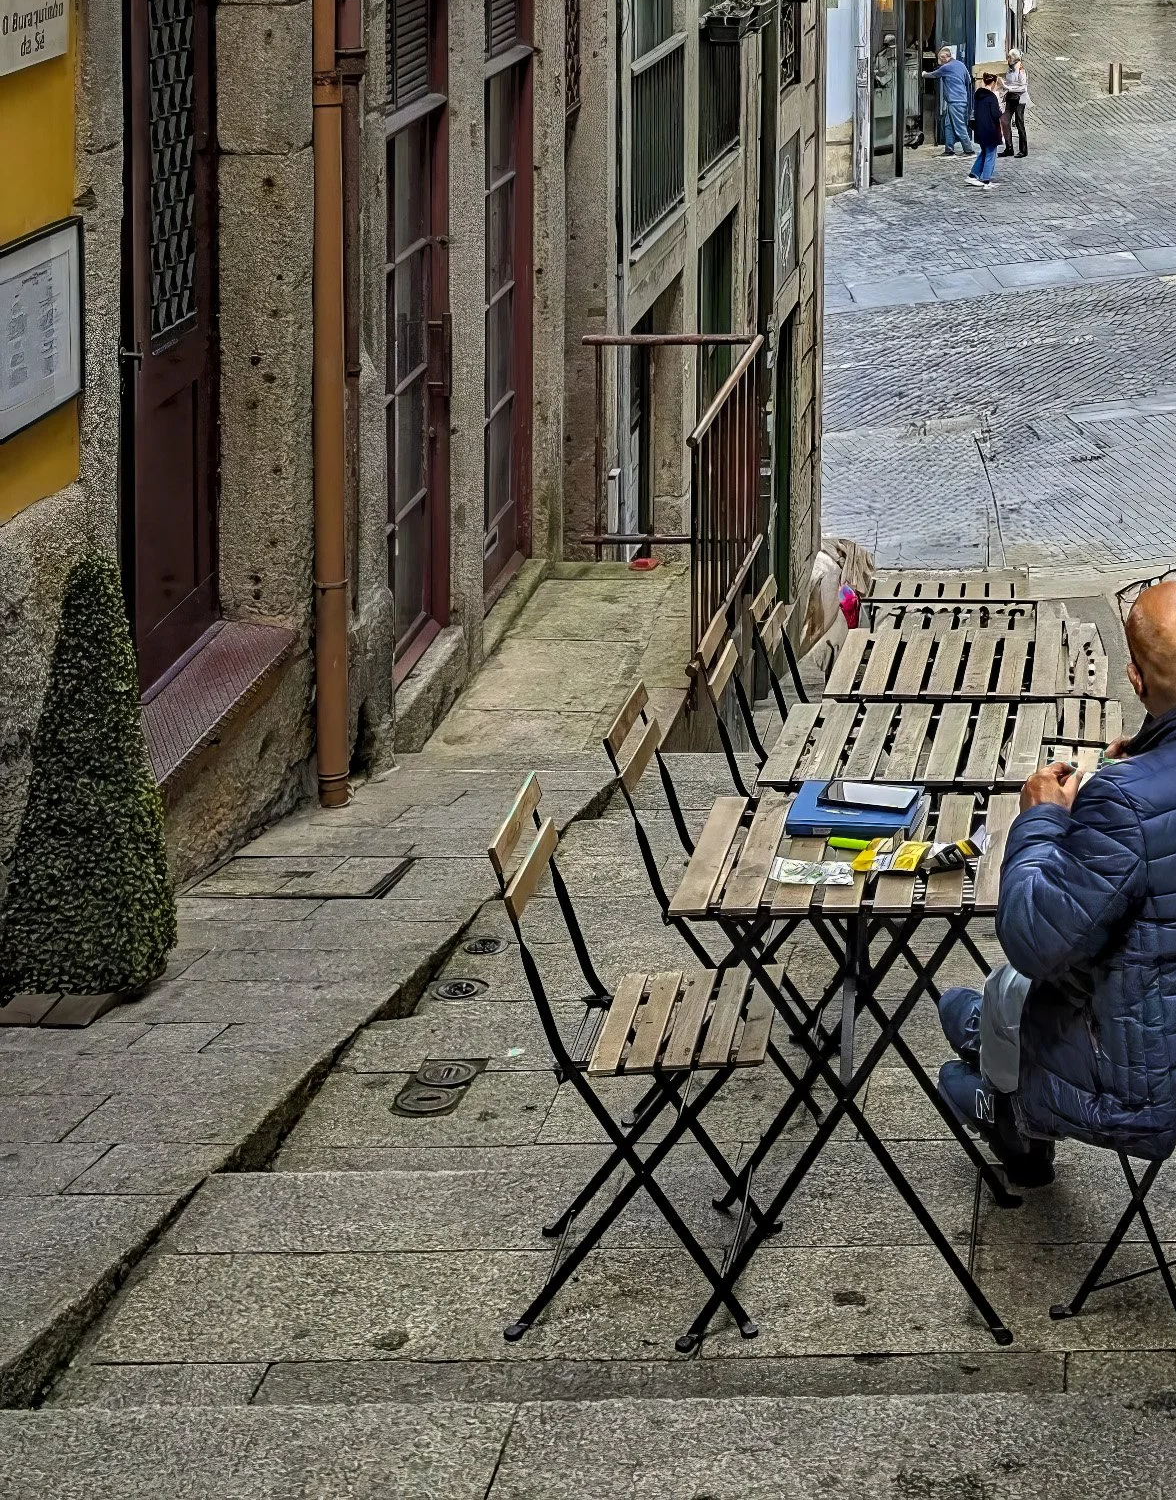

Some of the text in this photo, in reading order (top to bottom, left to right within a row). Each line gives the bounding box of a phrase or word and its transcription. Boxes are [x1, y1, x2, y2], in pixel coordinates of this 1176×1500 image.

[2, 15, 9, 36] O
[20, 35, 31, 57] da
[975, 1088, 995, 1123] N
